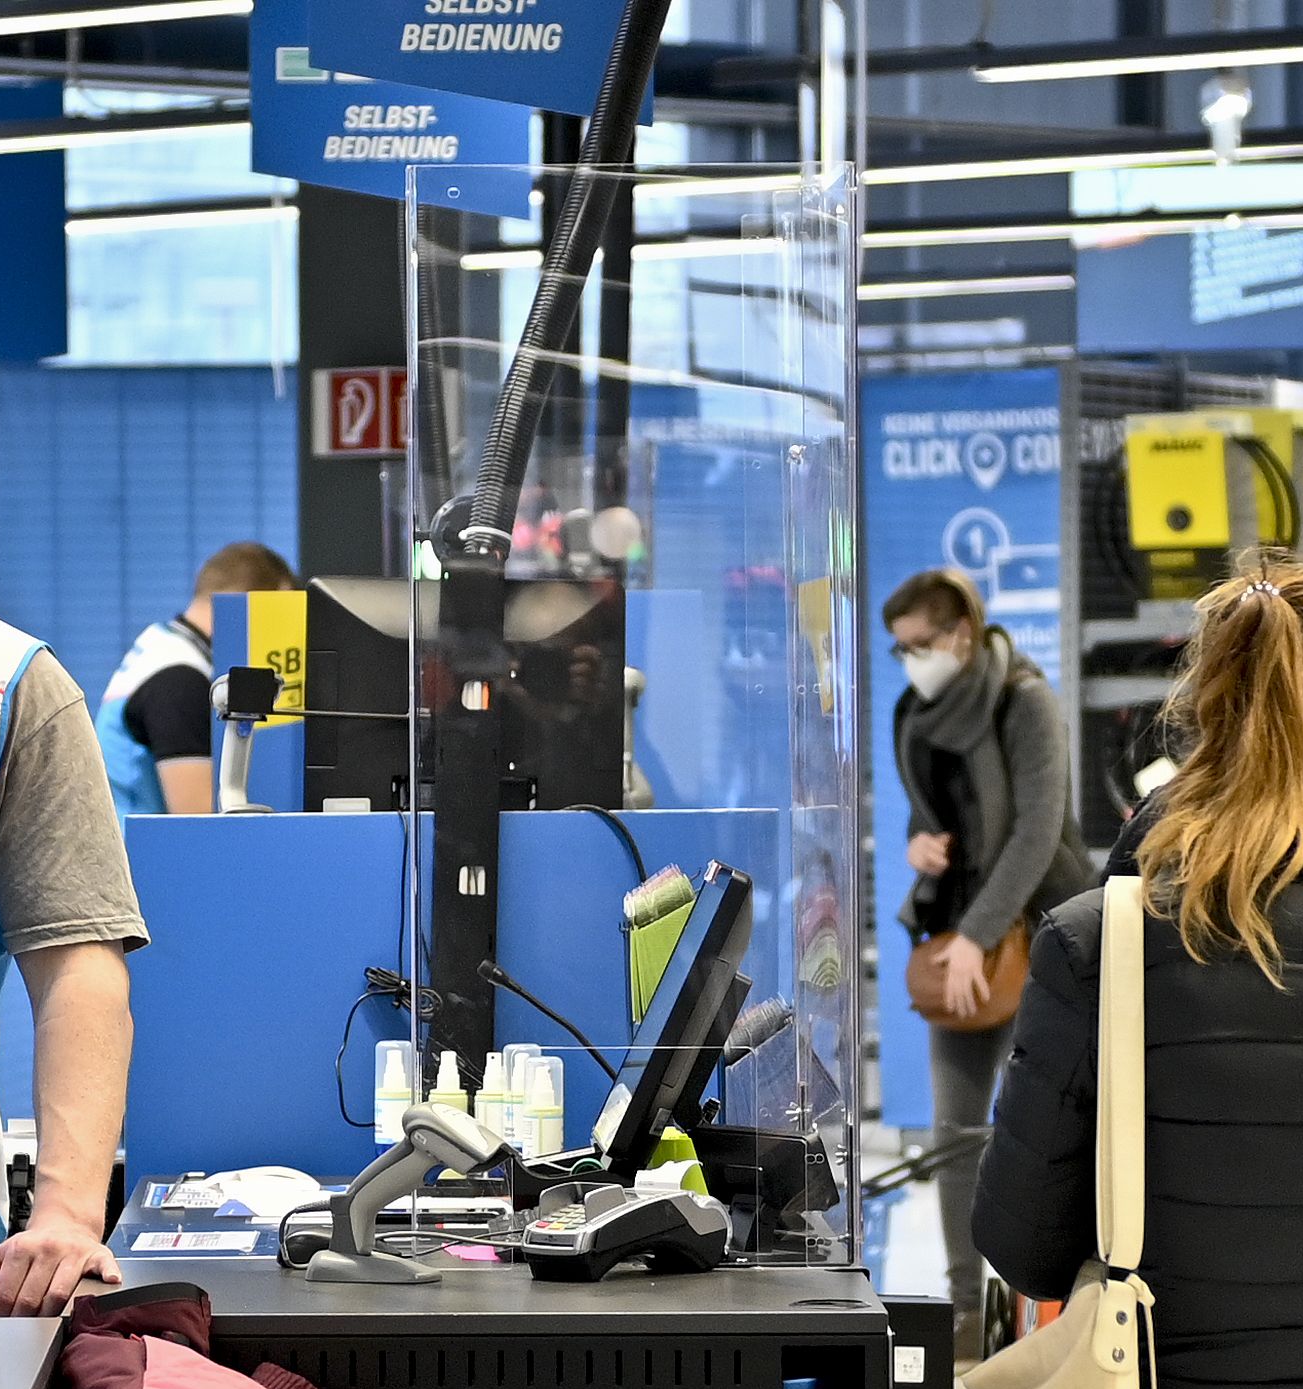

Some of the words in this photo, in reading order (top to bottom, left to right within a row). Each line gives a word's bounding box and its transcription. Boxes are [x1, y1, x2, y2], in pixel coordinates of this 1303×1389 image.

[400, 23, 563, 52] BEDIENUNG
[344, 105, 437, 130] SELBST-
[323, 135, 459, 161] BEDIENUNG
[883, 438, 963, 478] CLICK
[266, 648, 301, 674] SB
